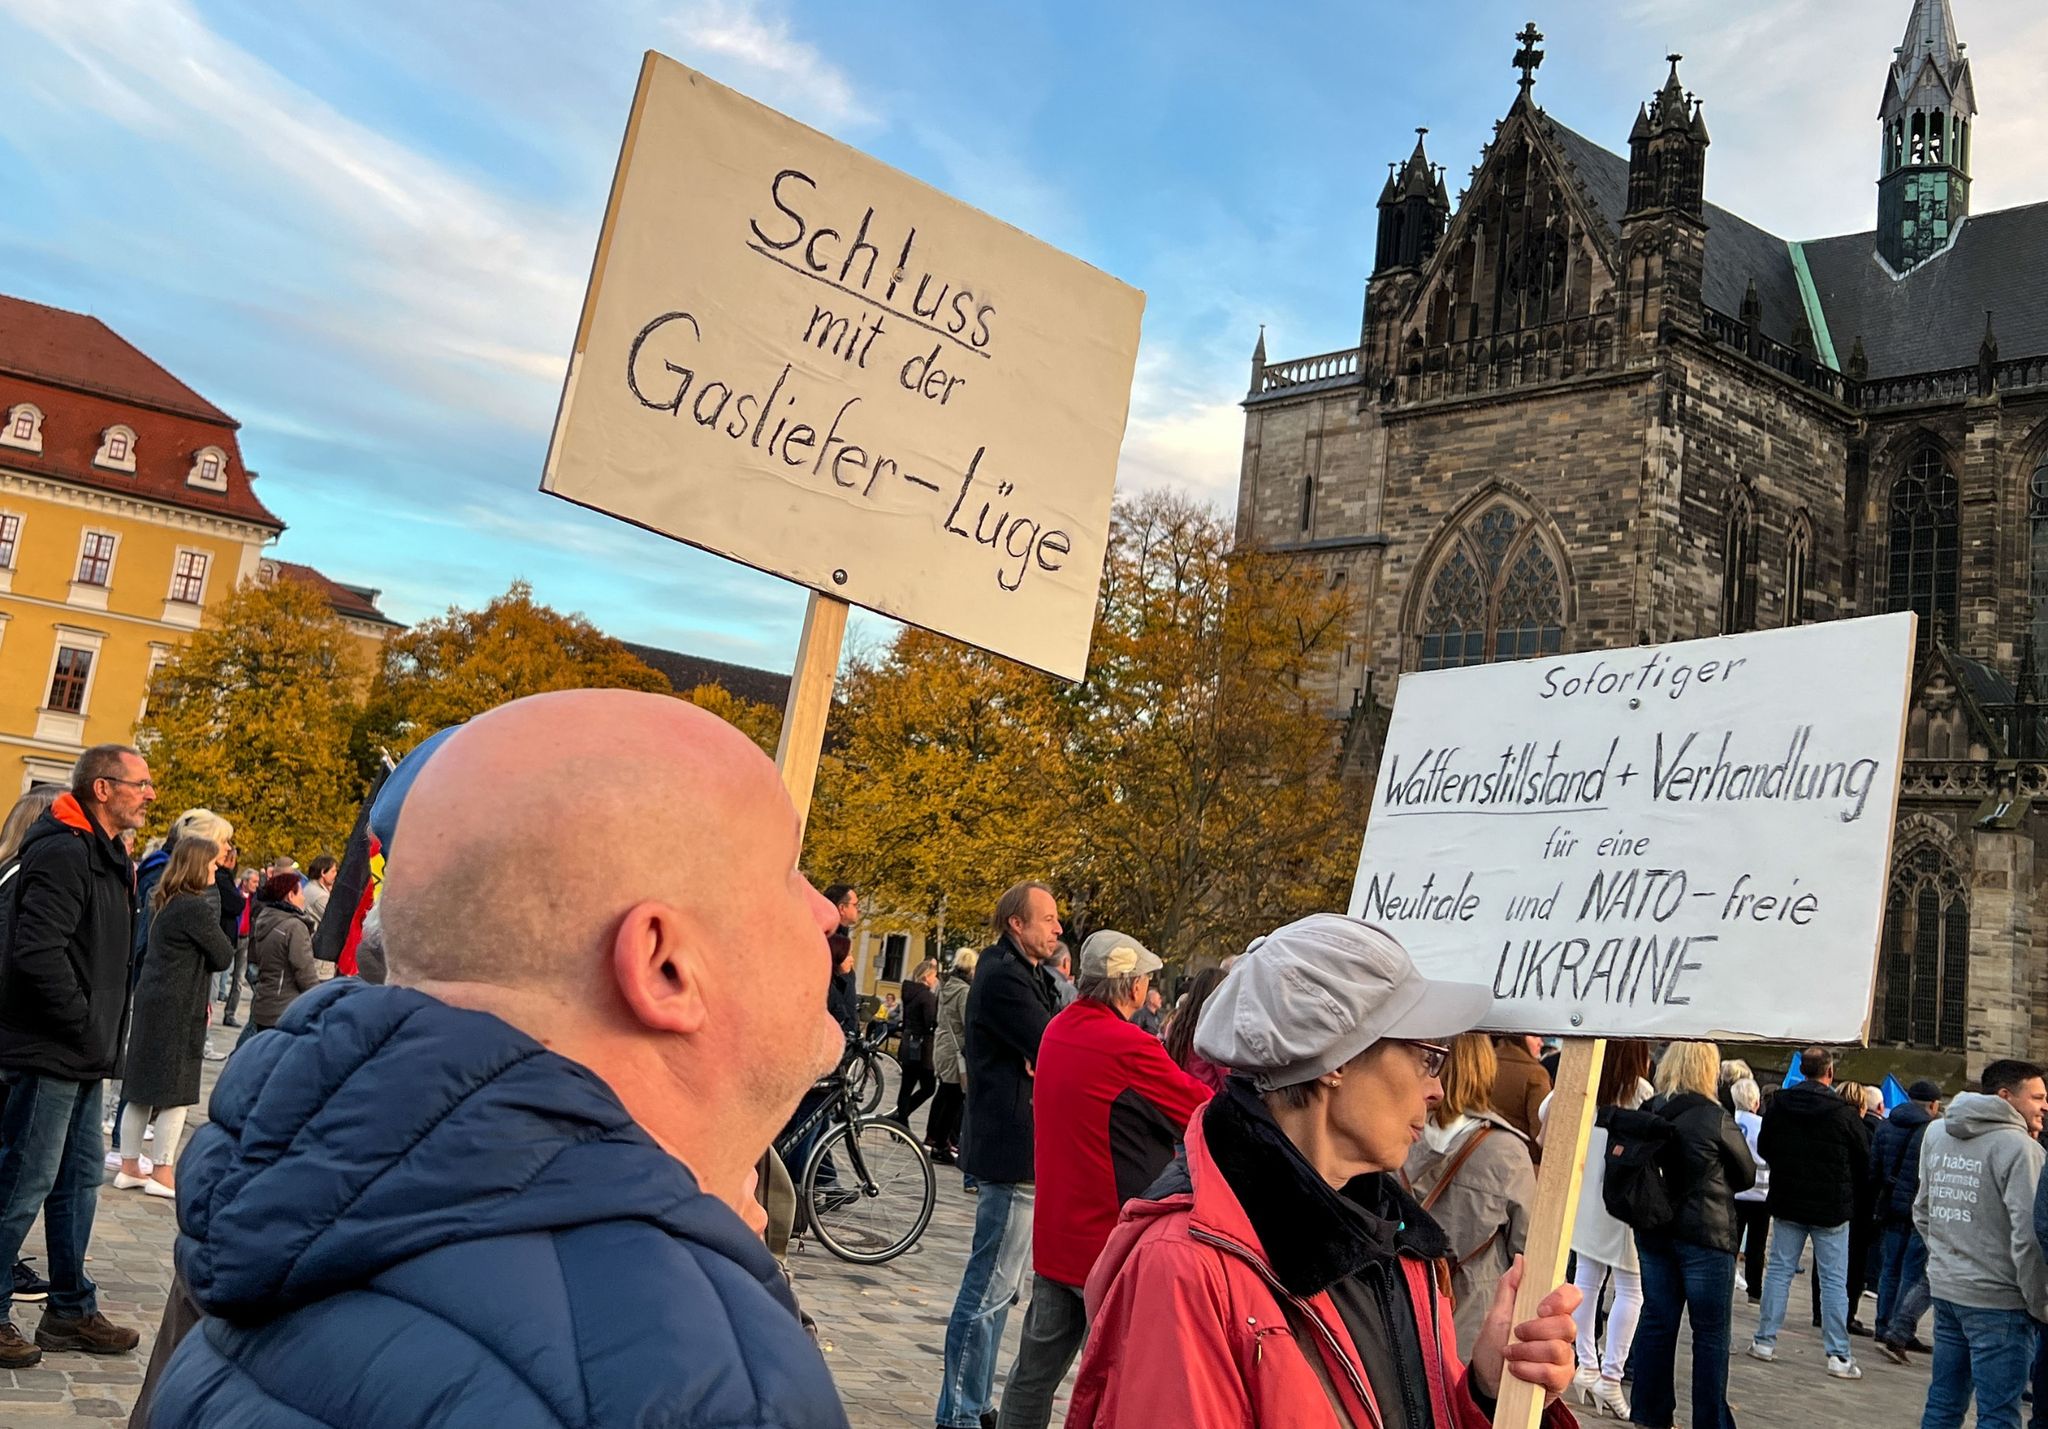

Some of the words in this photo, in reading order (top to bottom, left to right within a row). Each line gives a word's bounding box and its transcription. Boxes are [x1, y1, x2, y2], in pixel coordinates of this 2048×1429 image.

[750, 169, 997, 350] Schluss
[803, 305, 885, 369] mit
[900, 344, 965, 405] der
[627, 311, 1071, 591] Gasliefer-Lüge
[1540, 652, 1747, 699] Sofortiger
[1385, 736, 1619, 806] Waffenstillstand
[1617, 763, 1639, 786] +
[1652, 725, 1879, 822] Verhandlung
[1544, 826, 1578, 860] für
[1597, 828, 1650, 858] eine
[1362, 872, 1480, 923] Neutrale
[1506, 881, 1563, 922] und
[1577, 868, 1819, 925] NATO-freie
[1493, 934, 1718, 1007] UKRAINE
[1942, 1153, 1982, 1174] haben
